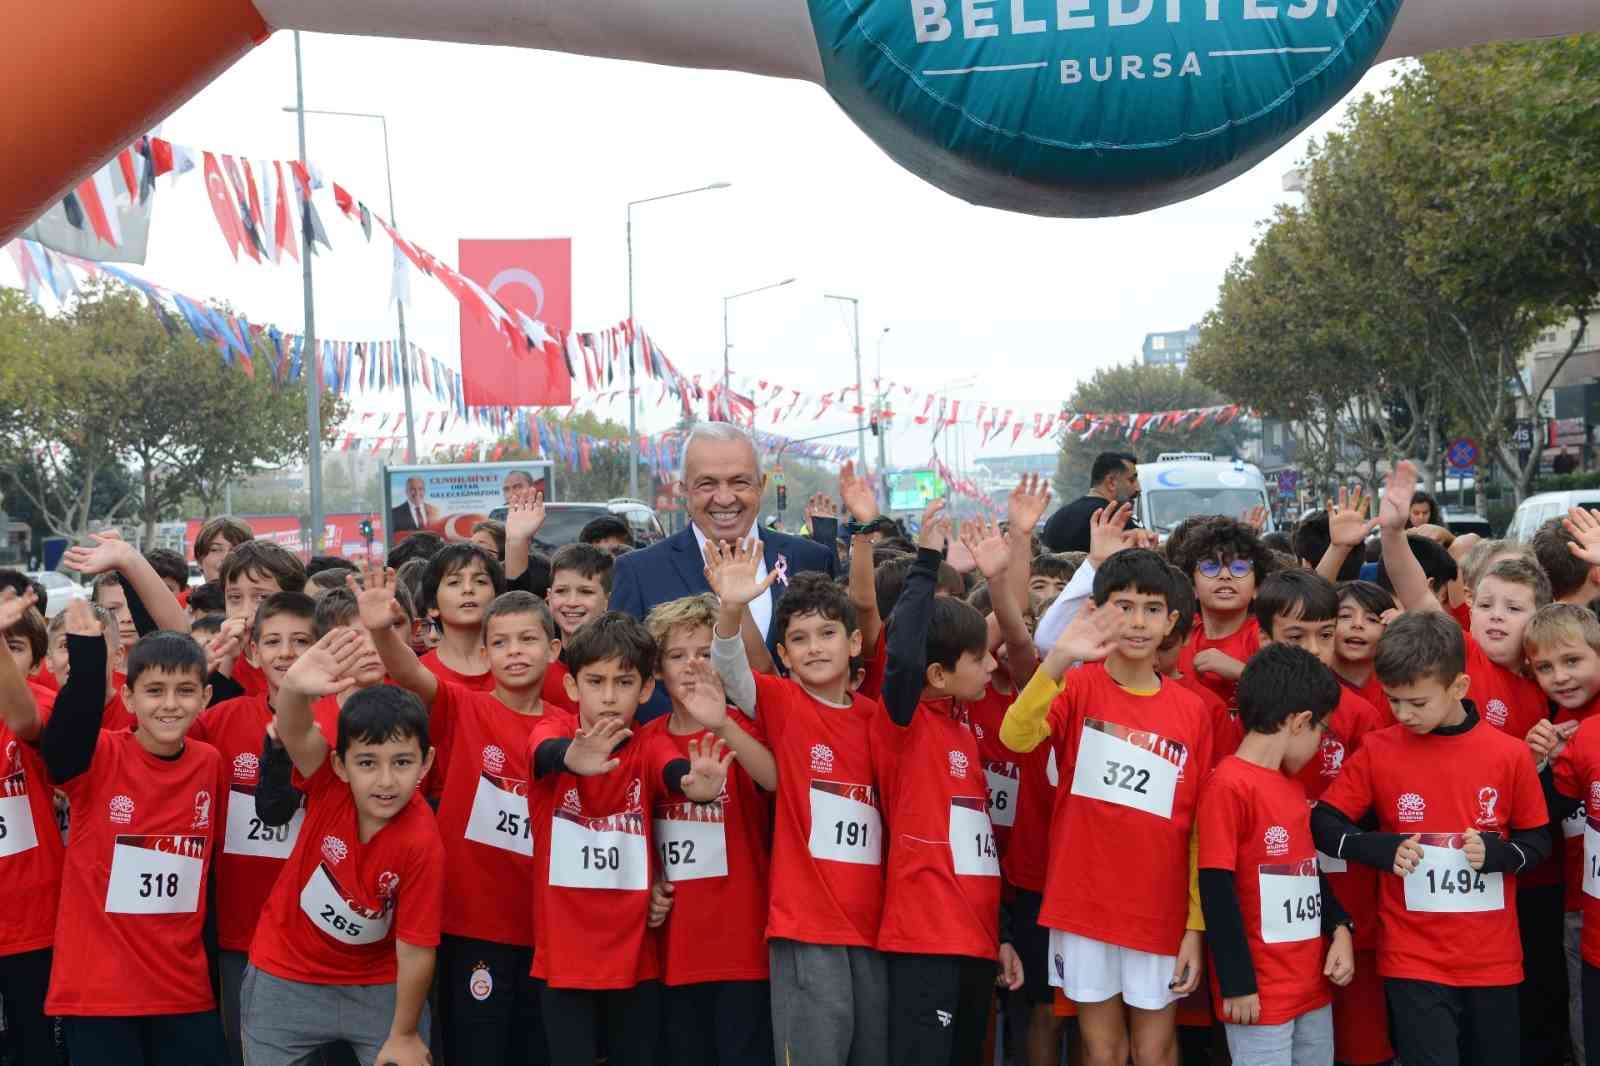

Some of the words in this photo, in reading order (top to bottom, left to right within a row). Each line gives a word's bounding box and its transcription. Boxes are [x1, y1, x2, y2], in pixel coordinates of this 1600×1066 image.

[1060, 52, 1202, 84] BURSA
[1103, 761, 1151, 795] 322
[496, 810, 532, 840] 251
[835, 820, 868, 847] 191
[581, 846, 620, 870] 150
[139, 873, 179, 898] 318
[1426, 869, 1486, 895] 1494
[320, 904, 363, 937] 265
